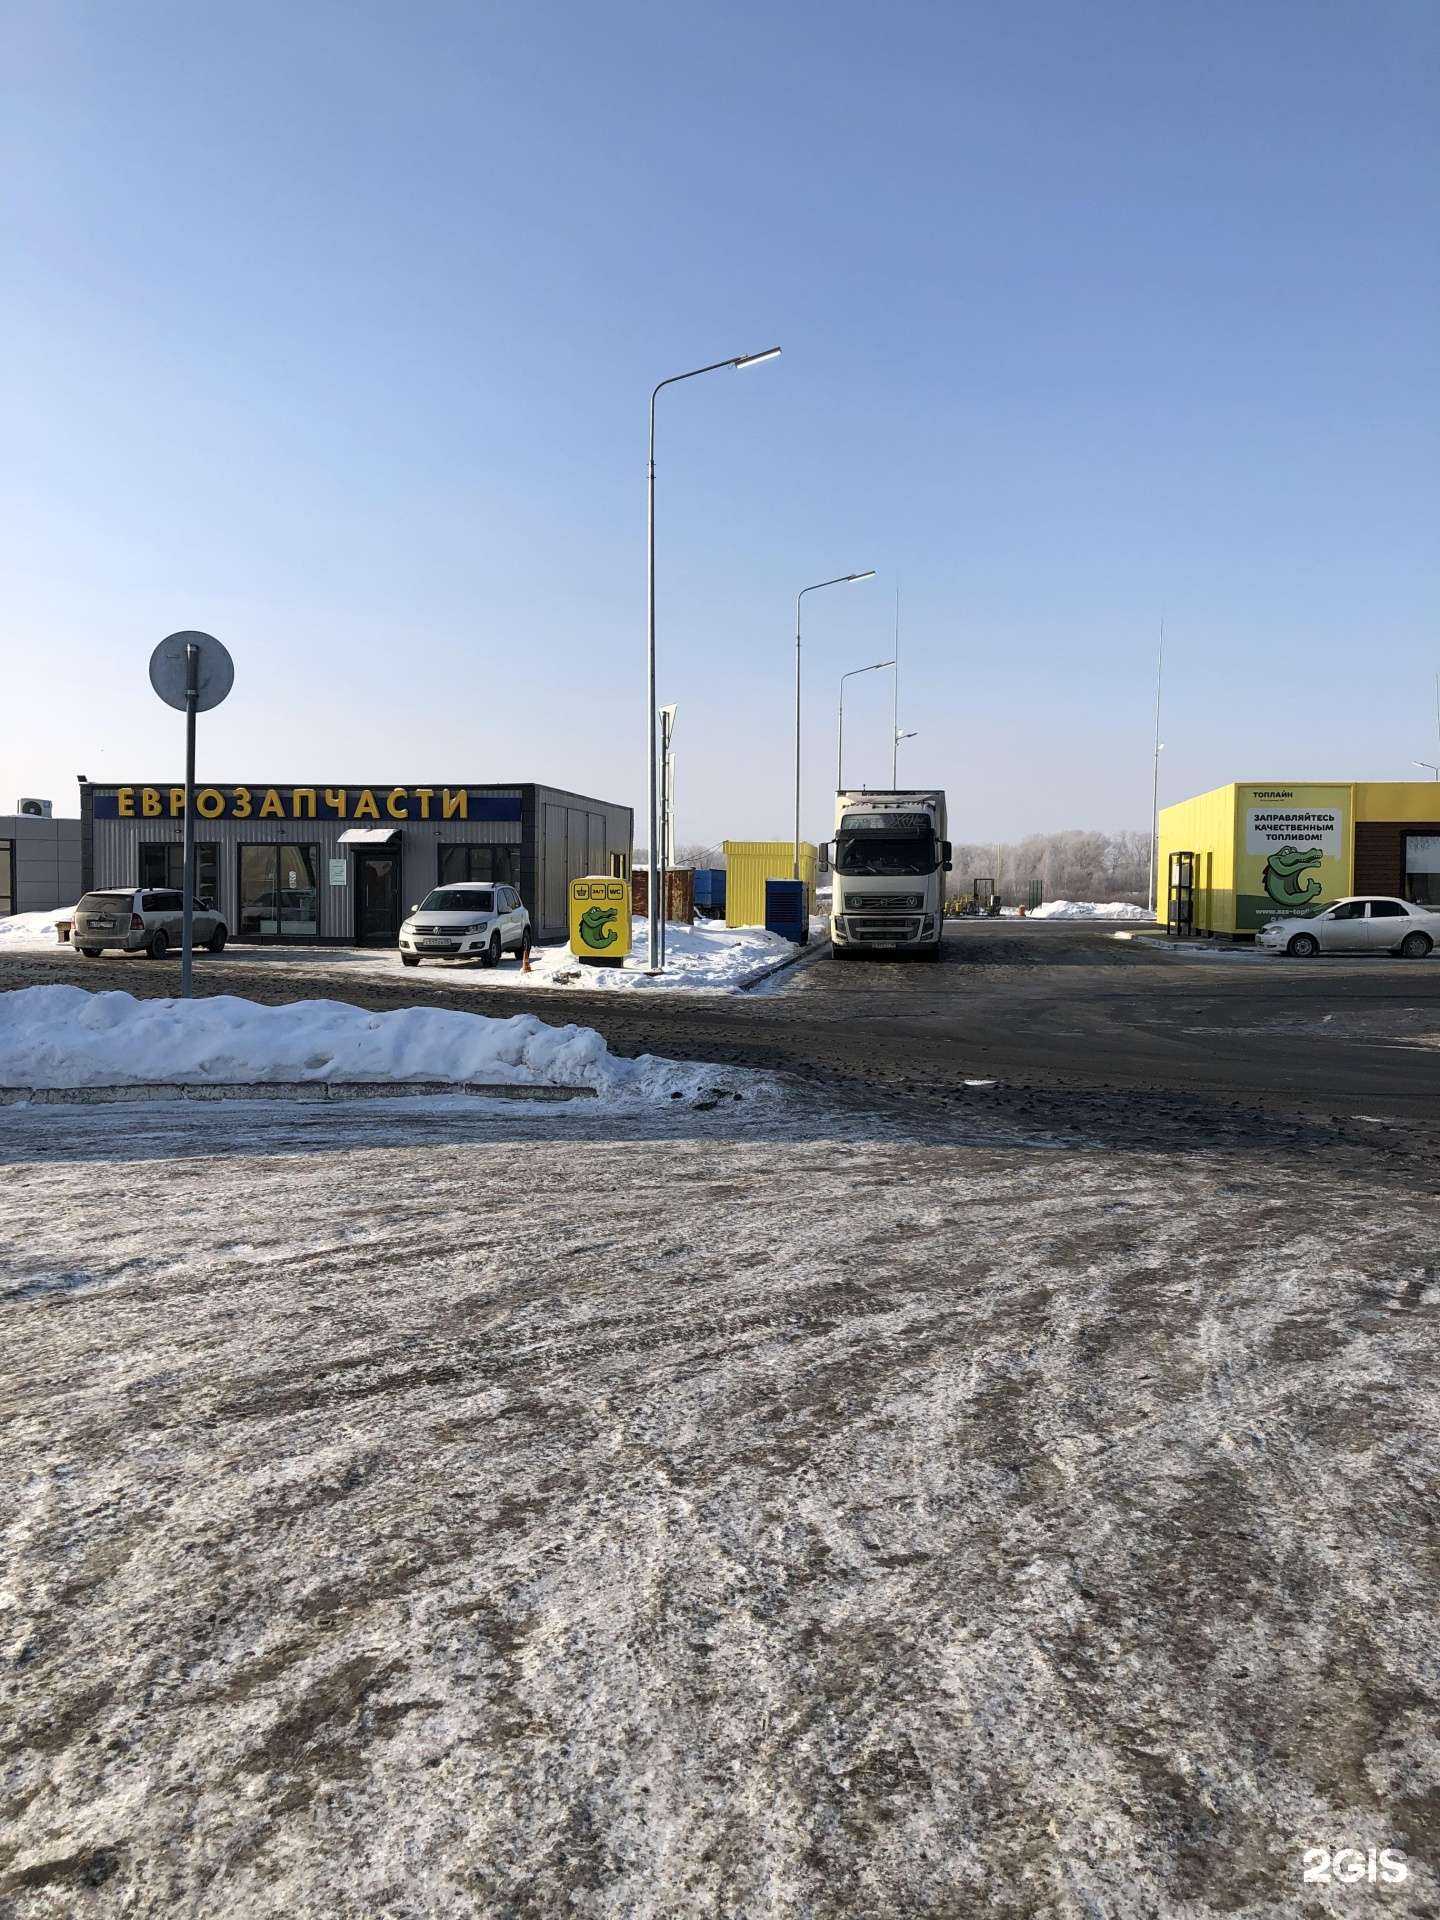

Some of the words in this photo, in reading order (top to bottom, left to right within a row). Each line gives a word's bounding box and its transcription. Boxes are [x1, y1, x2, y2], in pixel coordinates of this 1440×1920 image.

[1253, 790, 1293, 798] ТОПЛАЙН
[118, 787, 468, 818] ЕВРОЗАПЧАСТИ
[1254, 812, 1335, 822] ЗАПРАВЛЯЙТЕСЬ
[1266, 833, 1323, 841] ТОПЛИВОМ!
